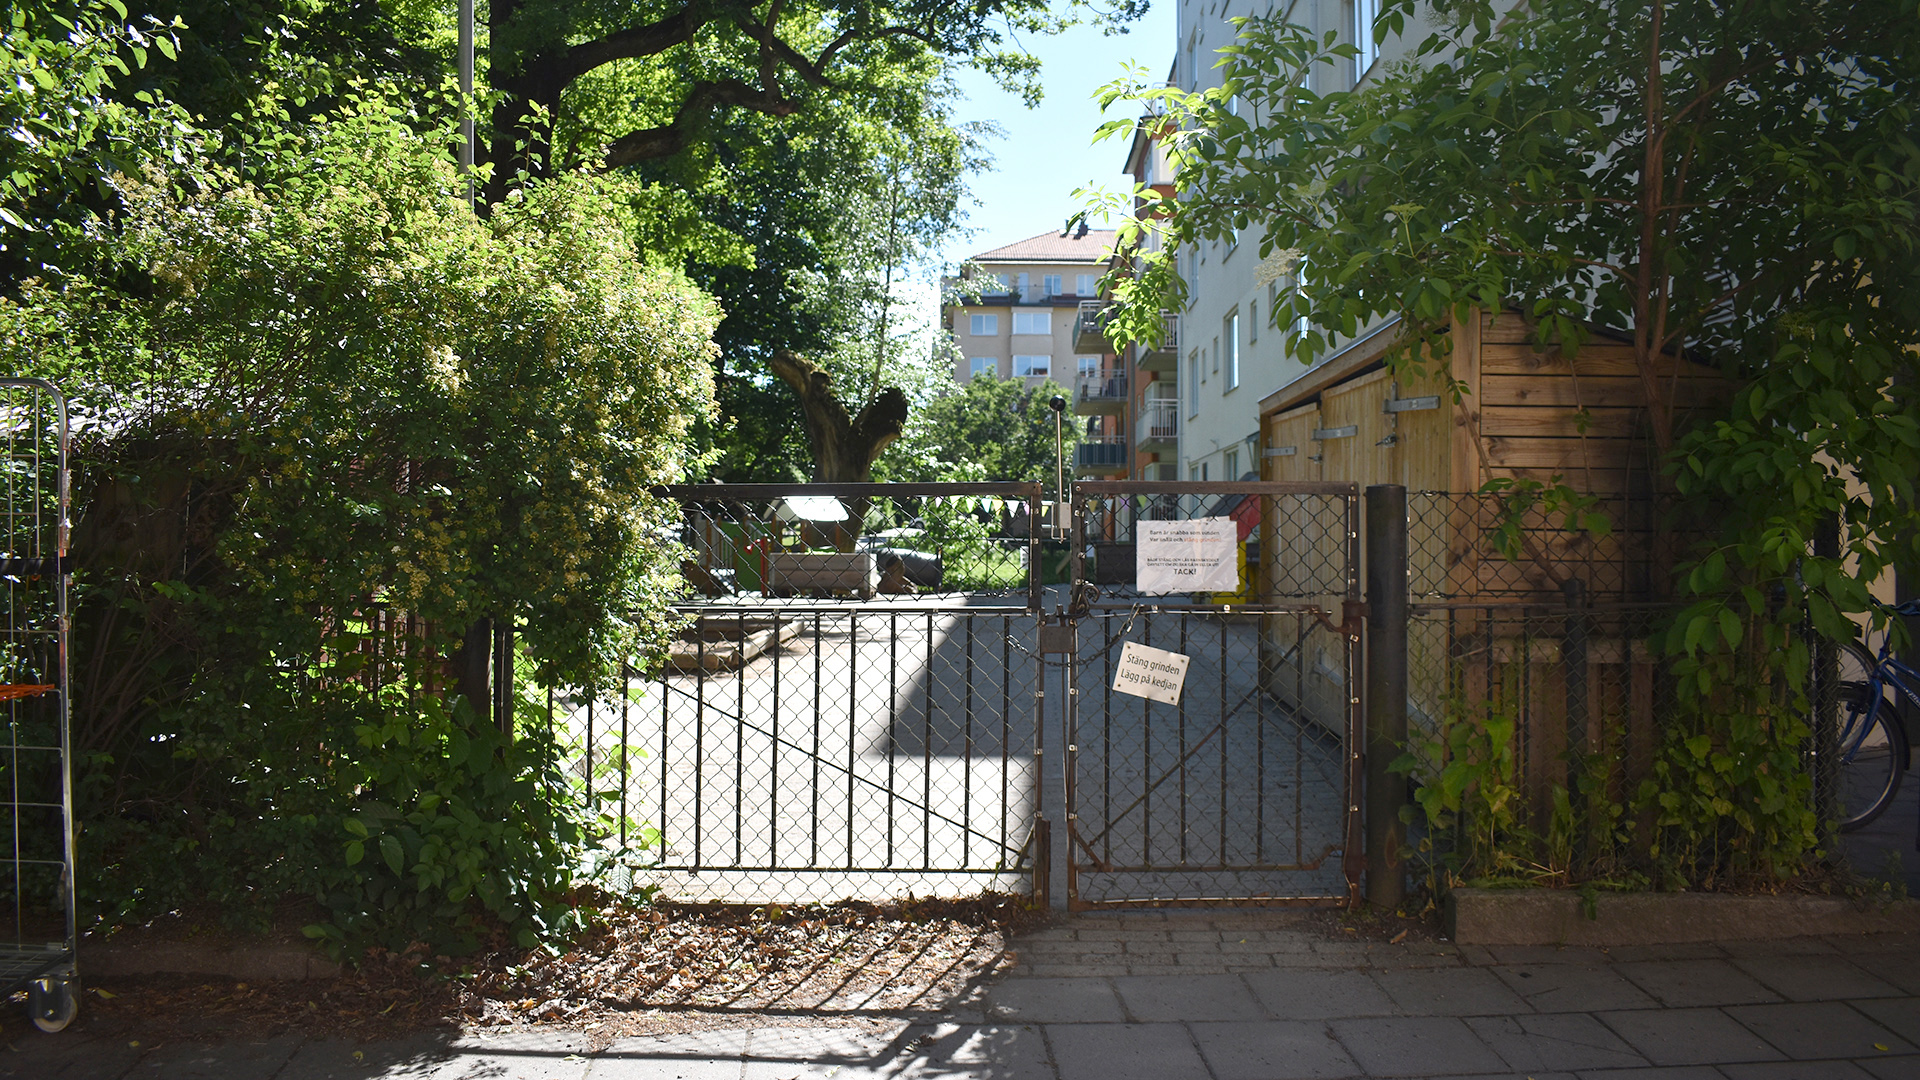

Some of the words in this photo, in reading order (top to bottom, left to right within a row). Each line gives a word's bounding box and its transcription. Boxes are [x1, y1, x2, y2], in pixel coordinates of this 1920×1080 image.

[1126, 653, 1149, 670] Stäng
[1150, 661, 1180, 675] grinden
[1120, 668, 1140, 683] Lägg
[1140, 674, 1151, 685] på
[1151, 676, 1178, 691] kedjan
